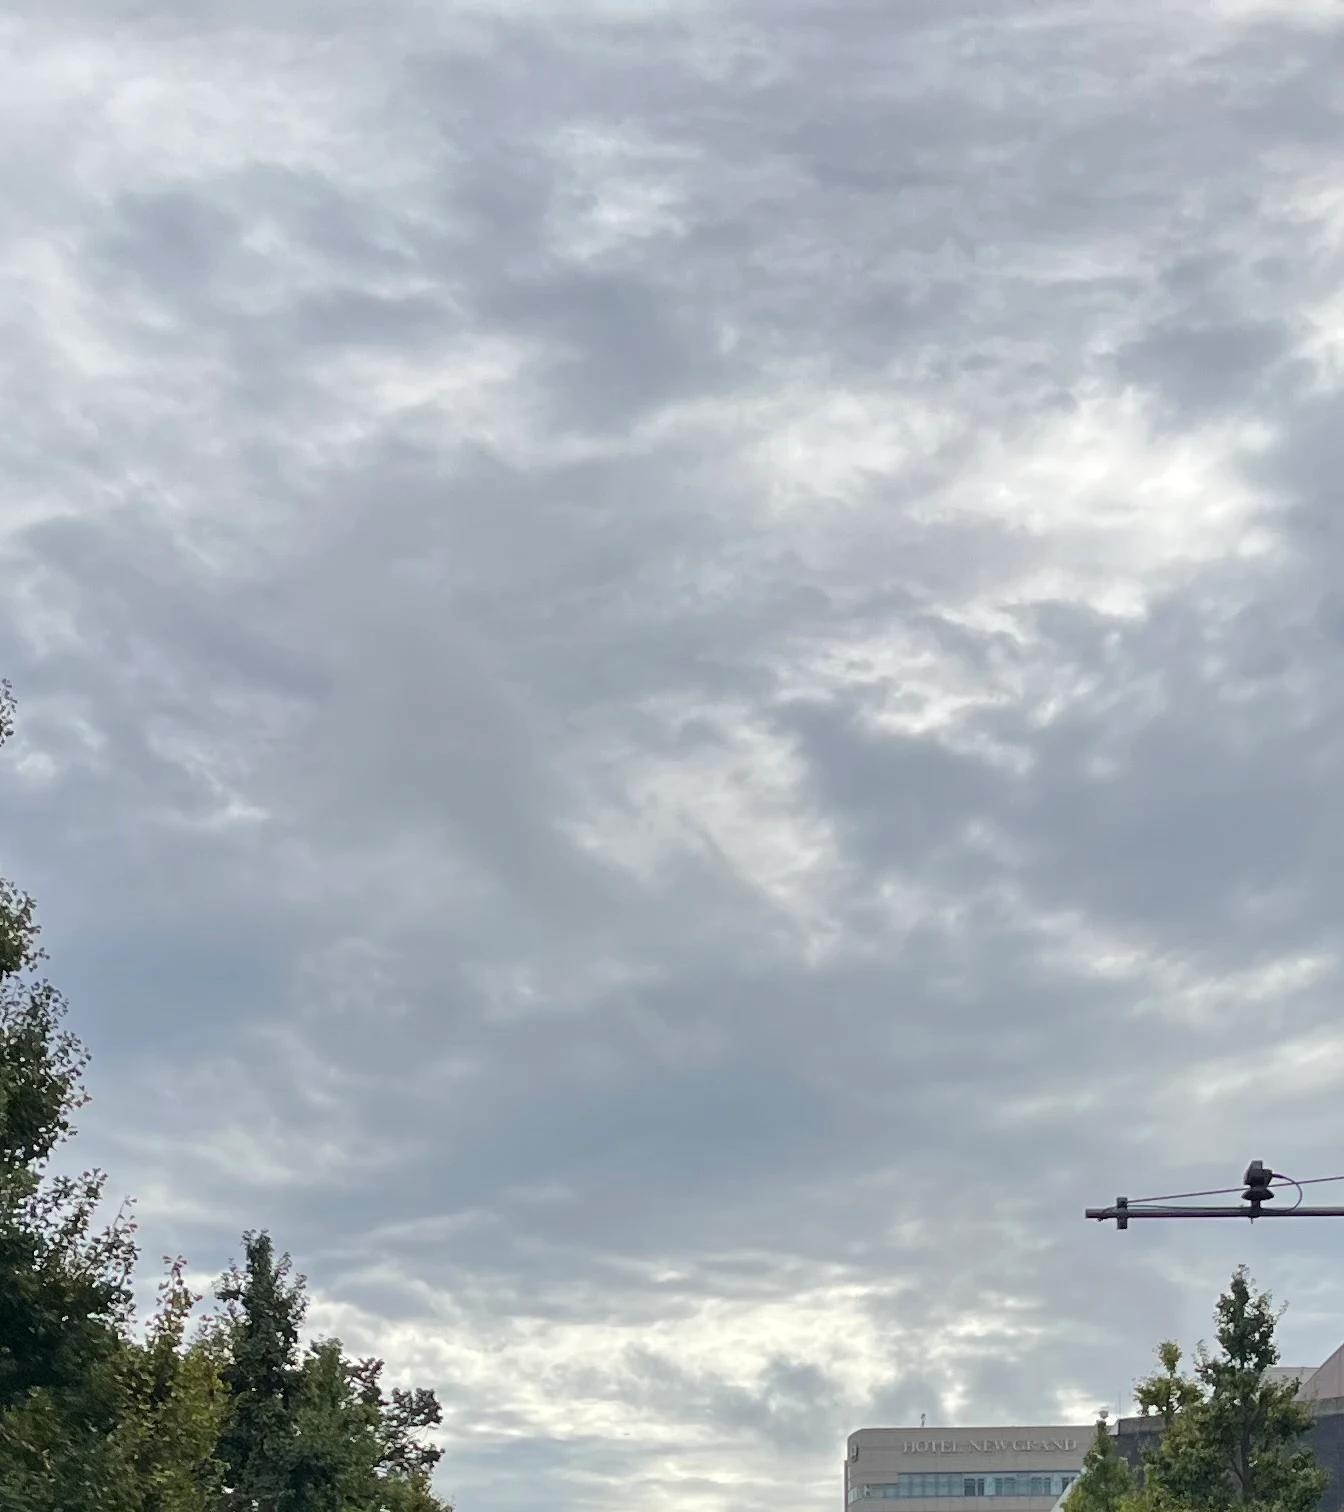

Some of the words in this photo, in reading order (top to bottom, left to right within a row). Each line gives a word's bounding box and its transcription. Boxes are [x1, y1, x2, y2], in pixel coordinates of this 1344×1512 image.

[903, 1439, 960, 1454] HOTEL
[969, 1439, 1007, 1452] NEW
[1012, 1438, 1077, 1452] GRAND
